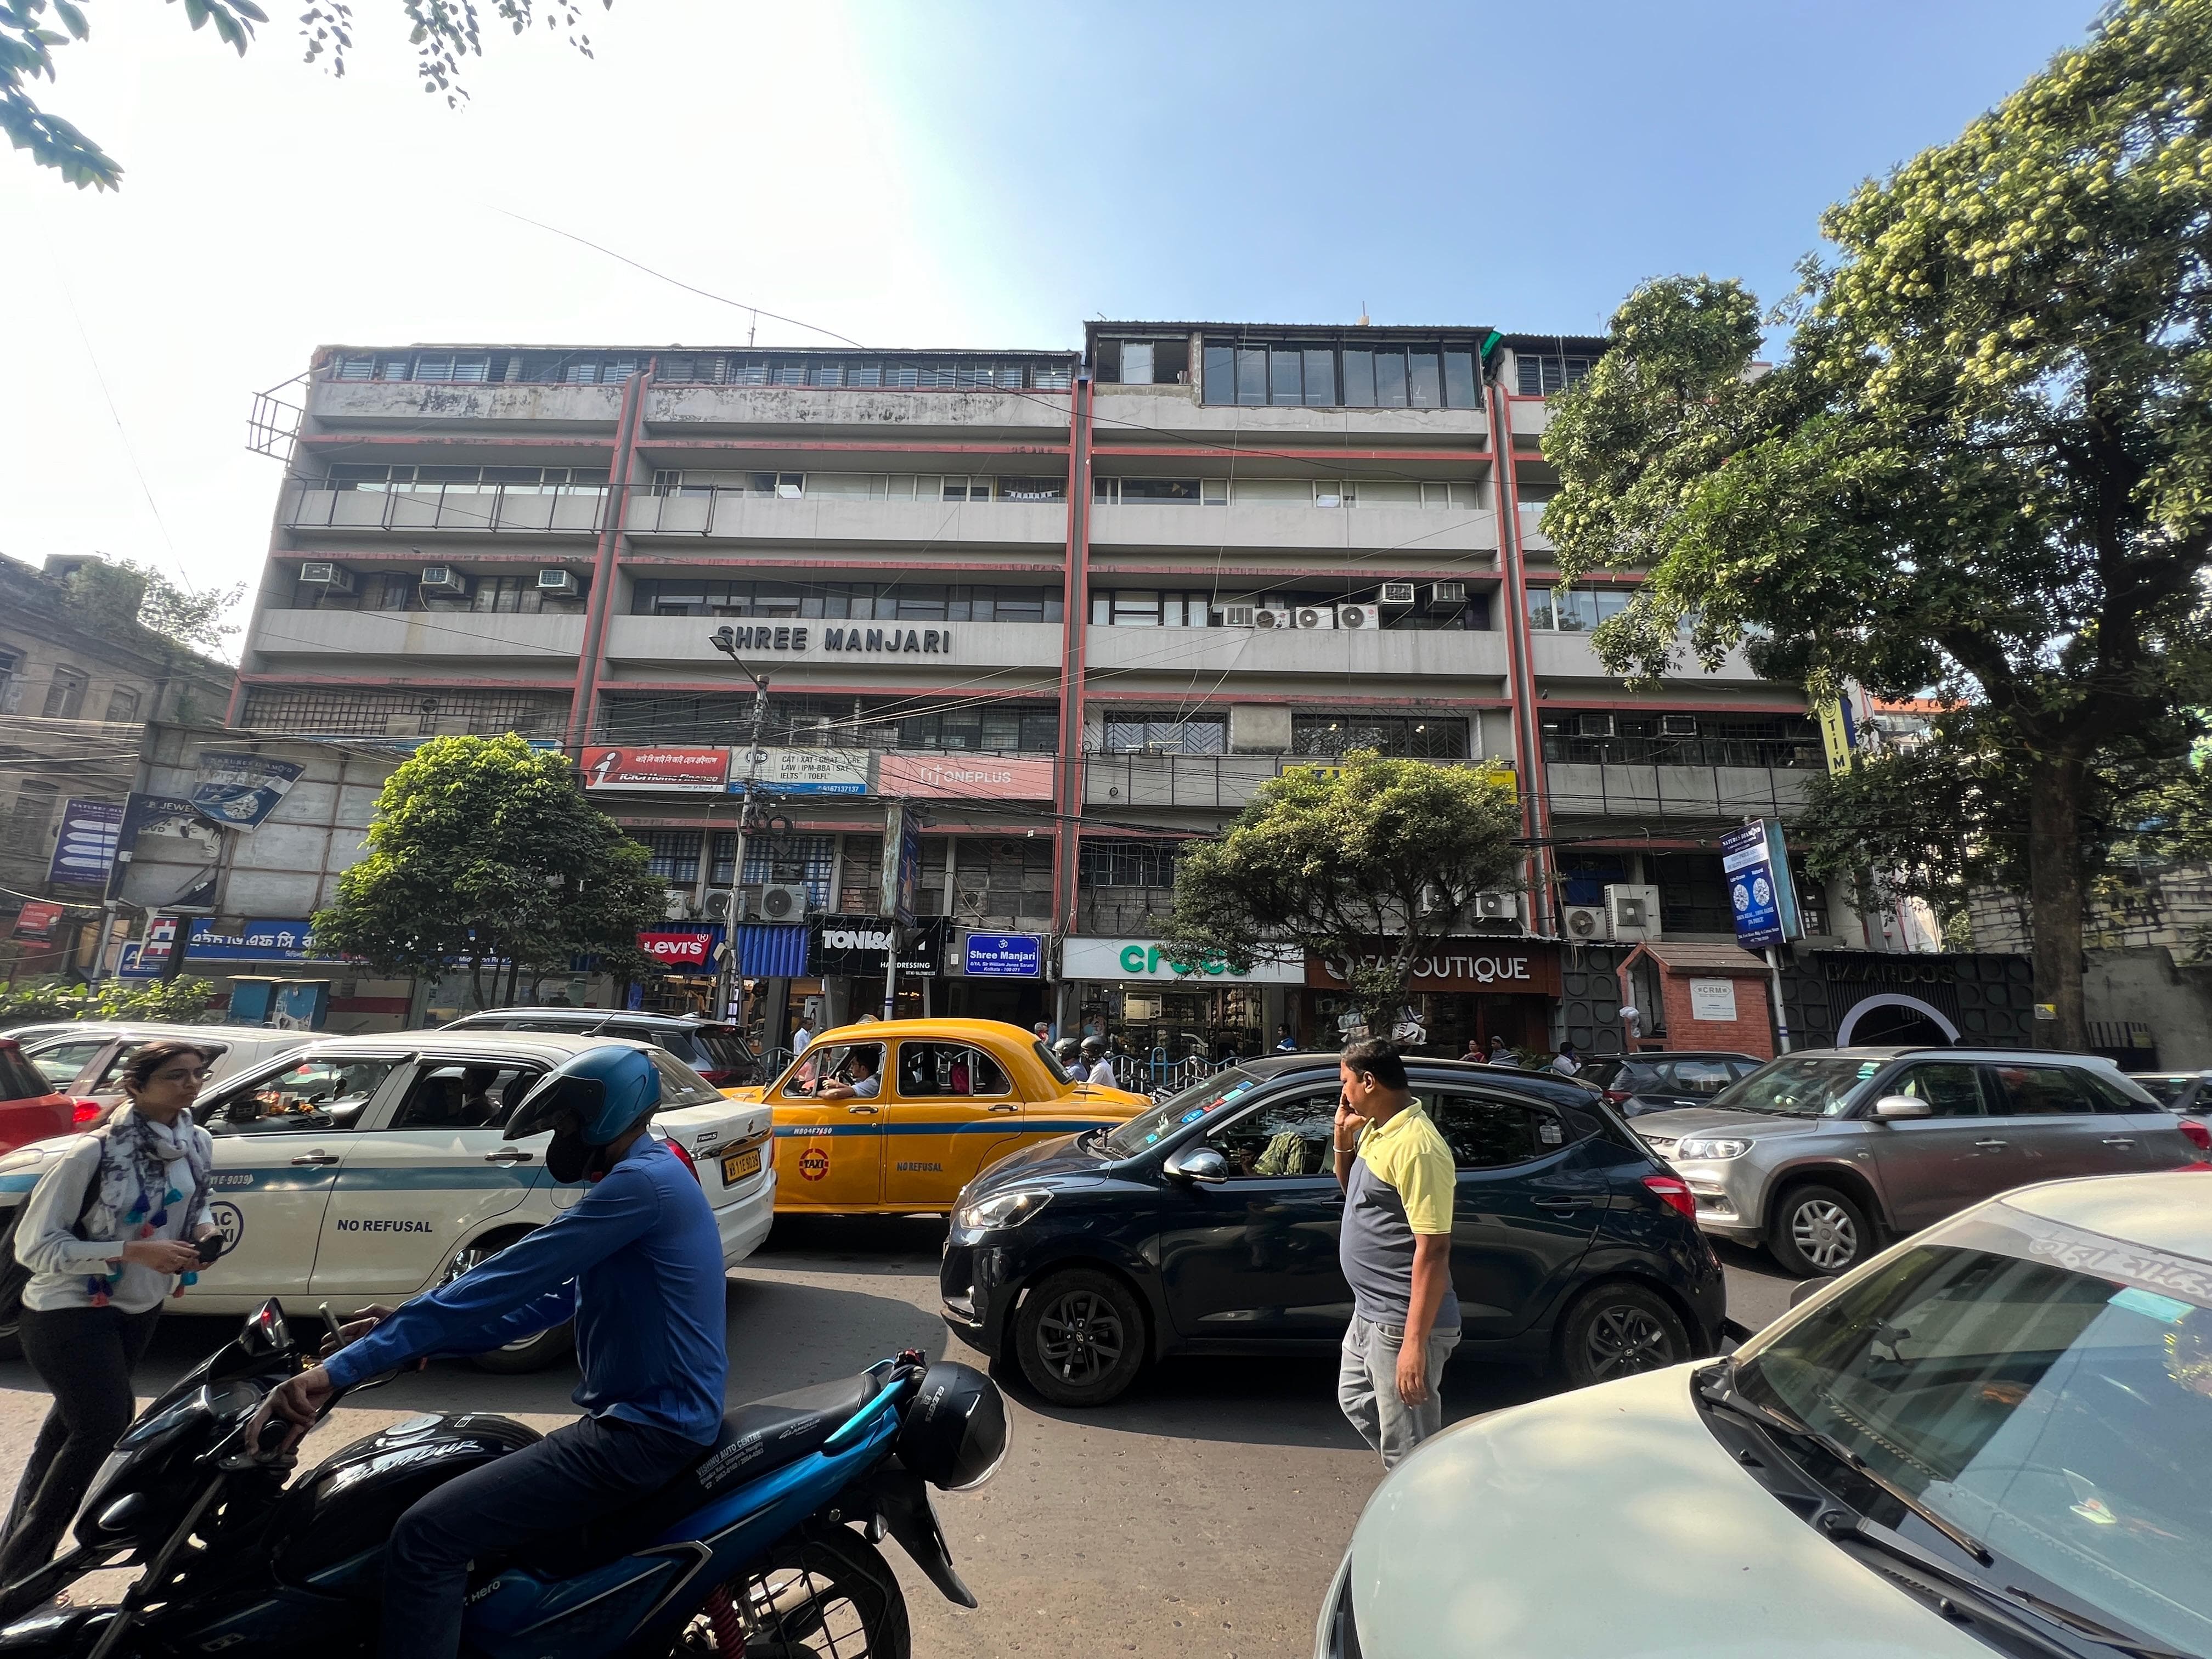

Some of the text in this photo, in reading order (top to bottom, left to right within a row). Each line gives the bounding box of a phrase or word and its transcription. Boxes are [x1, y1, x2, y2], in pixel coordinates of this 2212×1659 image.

[718, 625, 950, 653] SHREE MANJARI
[944, 771, 1011, 783] ONEPLUS
[969, 950, 1036, 962] Shree Manjari
[804, 1159, 825, 1169] TAXI
[896, 1162, 943, 1172] NO REFUSAL
[337, 1220, 433, 1233] NO REFUSAL
[696, 1431, 762, 1476] VISHNU AUTO CENTRE
